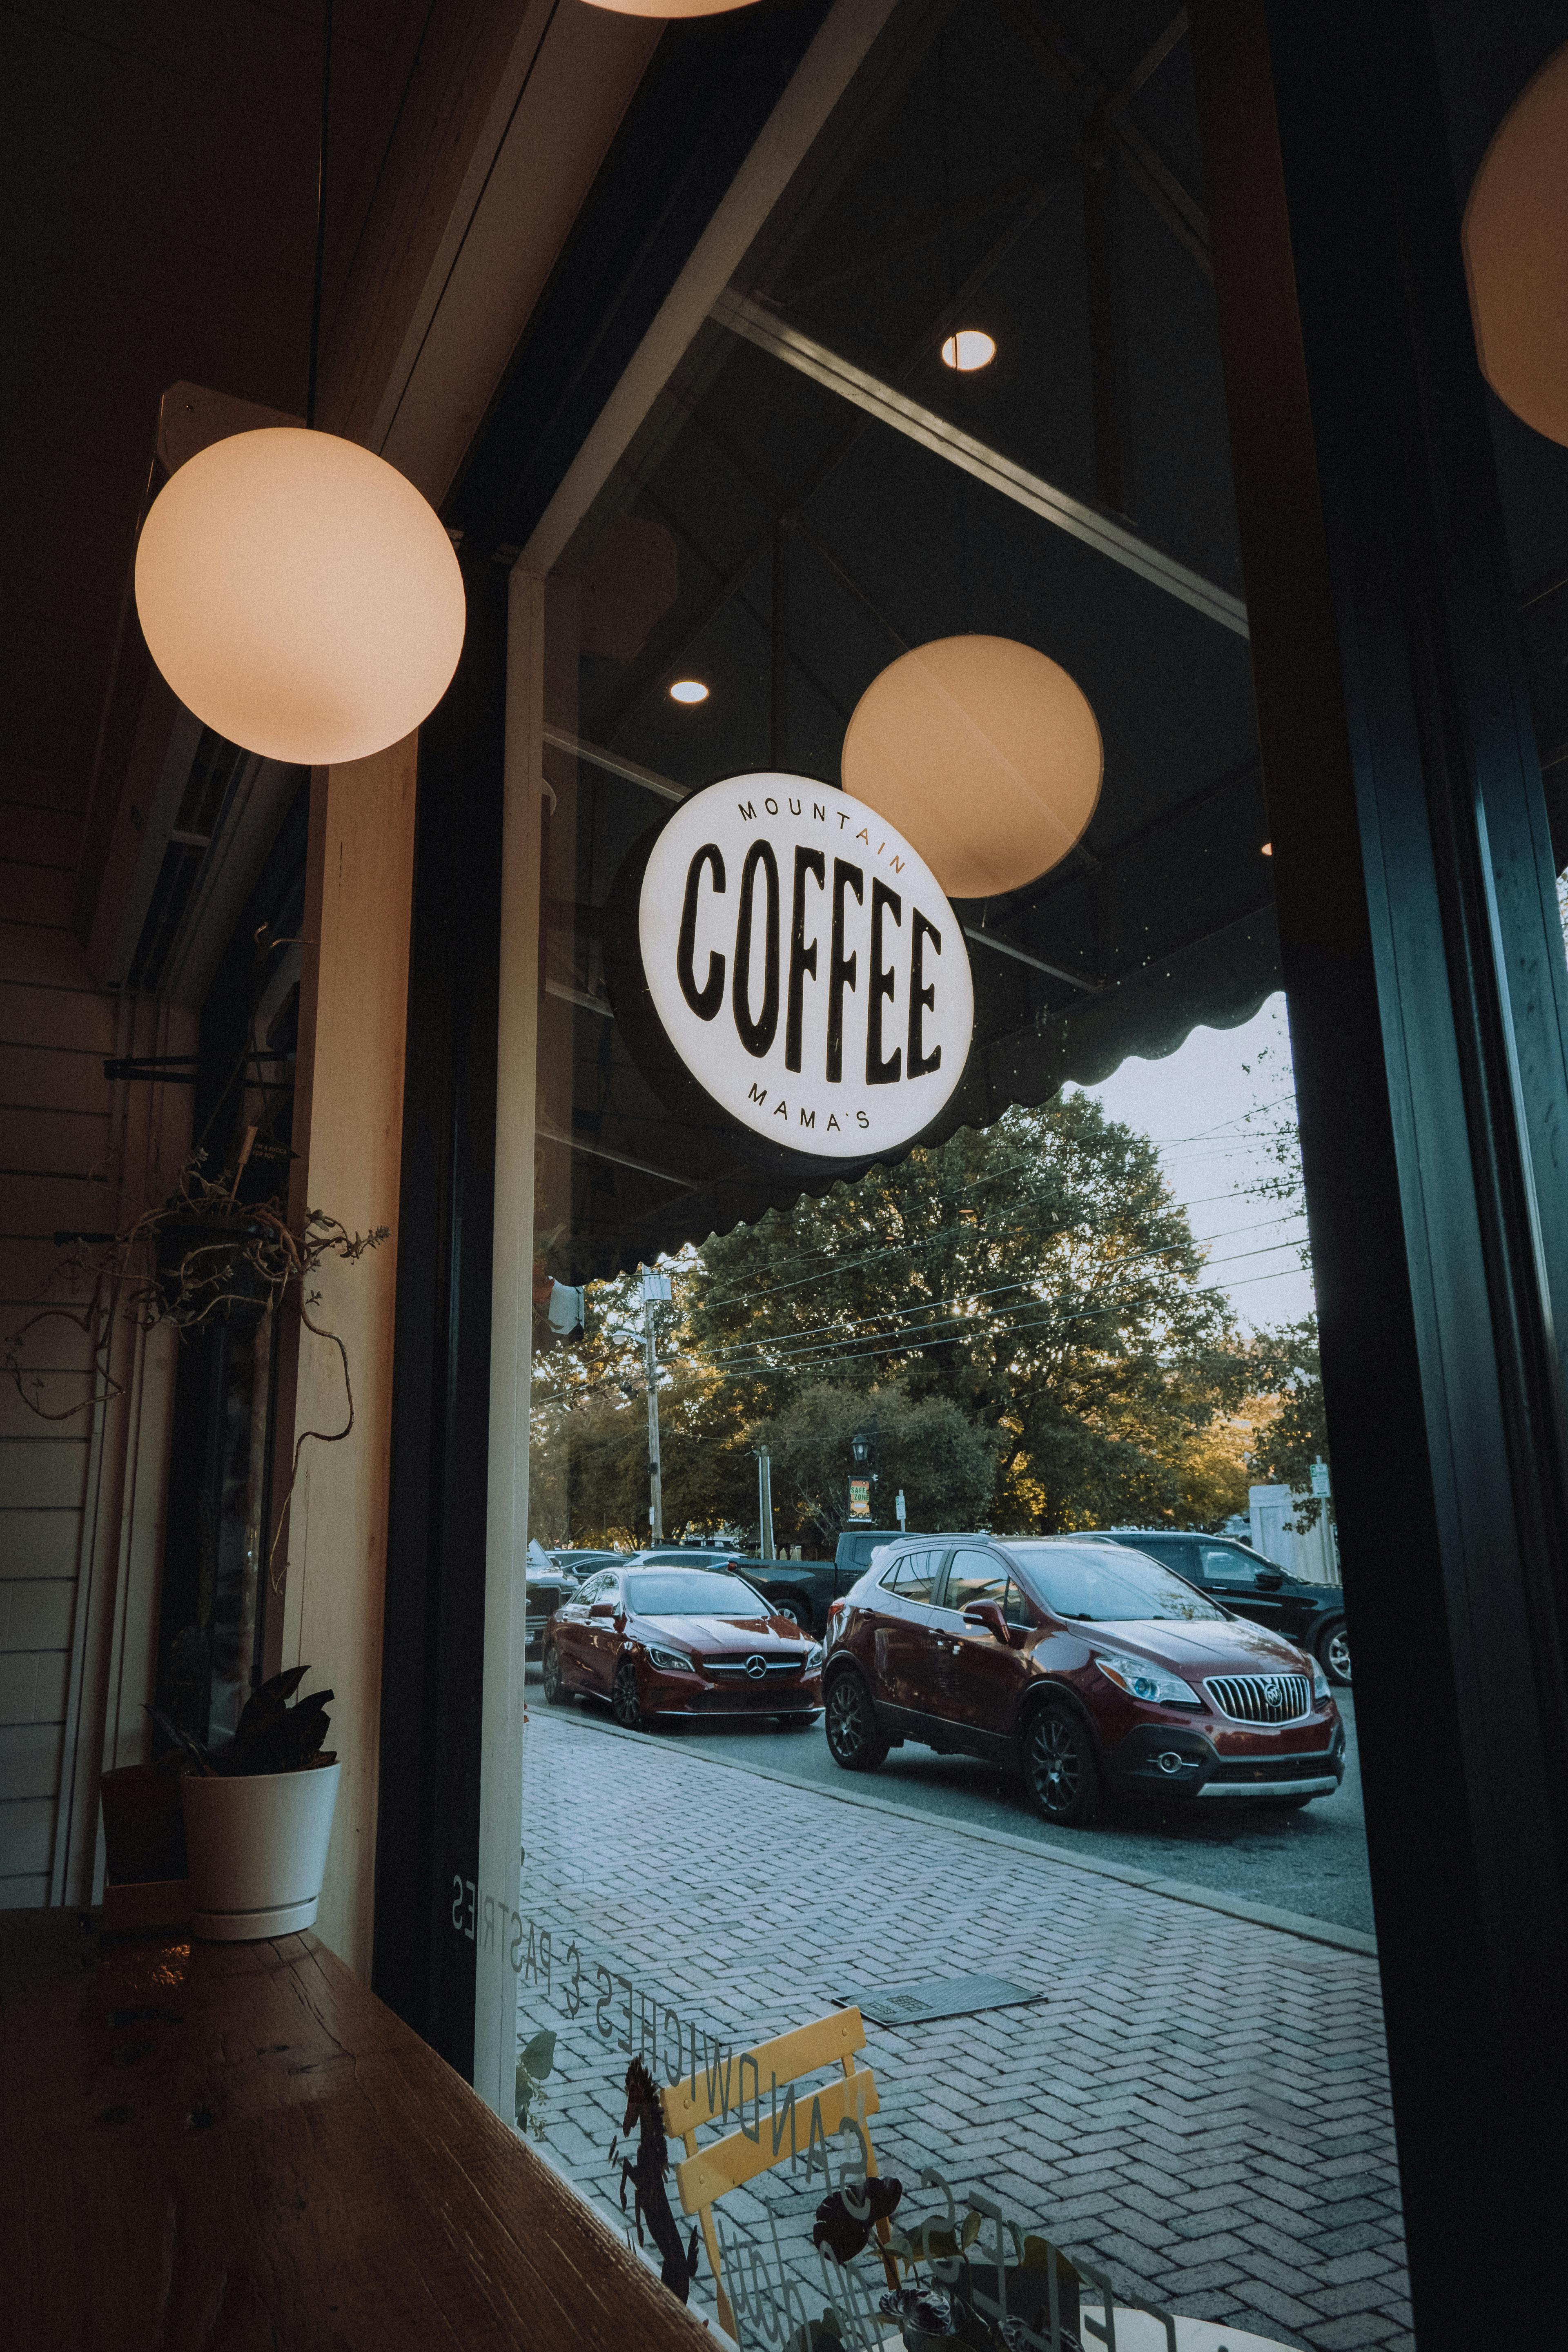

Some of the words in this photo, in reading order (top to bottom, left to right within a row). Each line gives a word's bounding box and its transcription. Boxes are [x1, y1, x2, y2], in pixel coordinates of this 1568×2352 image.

[738, 797, 905, 874] MOUNTAIN
[677, 839, 942, 1086] COFFEE
[748, 1082, 870, 1132] MAMA'S
